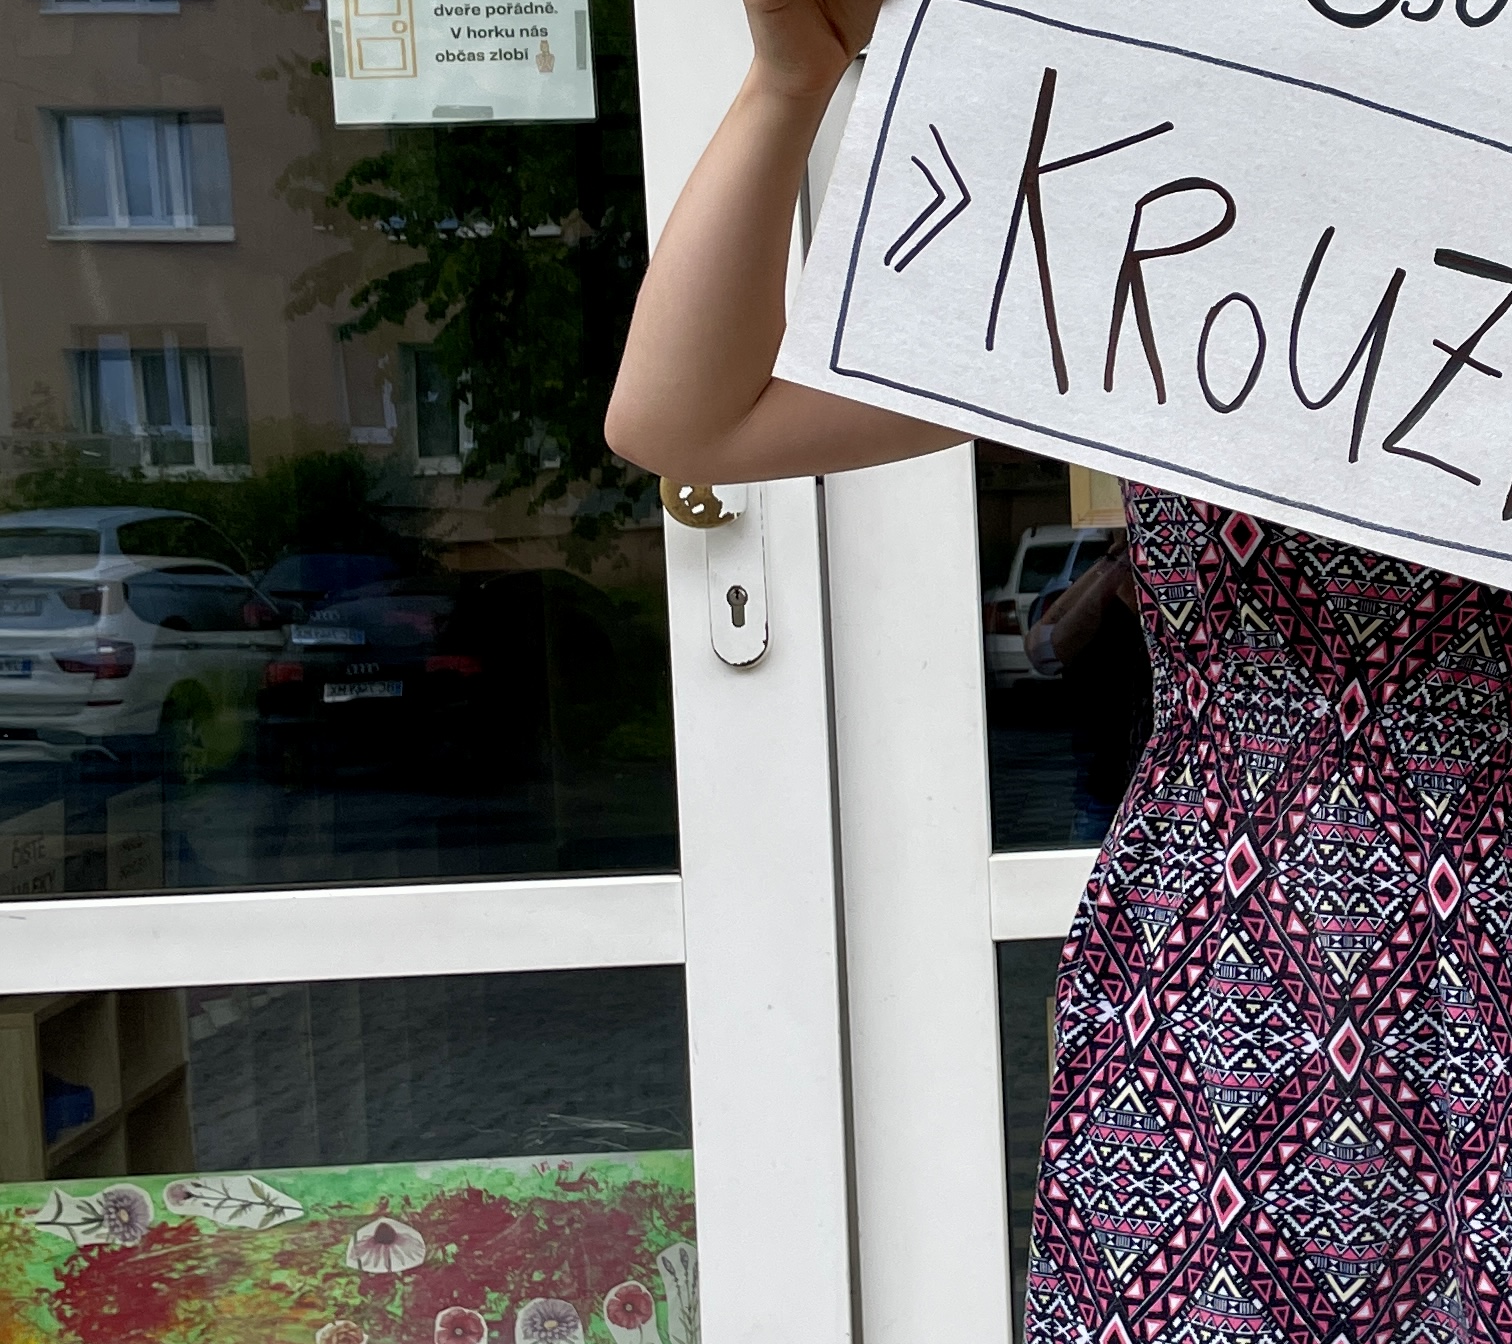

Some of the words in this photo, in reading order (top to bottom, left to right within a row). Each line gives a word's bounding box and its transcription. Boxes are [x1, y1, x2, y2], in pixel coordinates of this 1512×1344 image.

[433, 3, 481, 17] dveře
[485, 1, 558, 18] pořádně.
[450, 27, 462, 39] V
[466, 26, 516, 39] horku
[519, 25, 549, 38] nás
[435, 48, 485, 63] občas
[489, 47, 530, 62] zlobí
